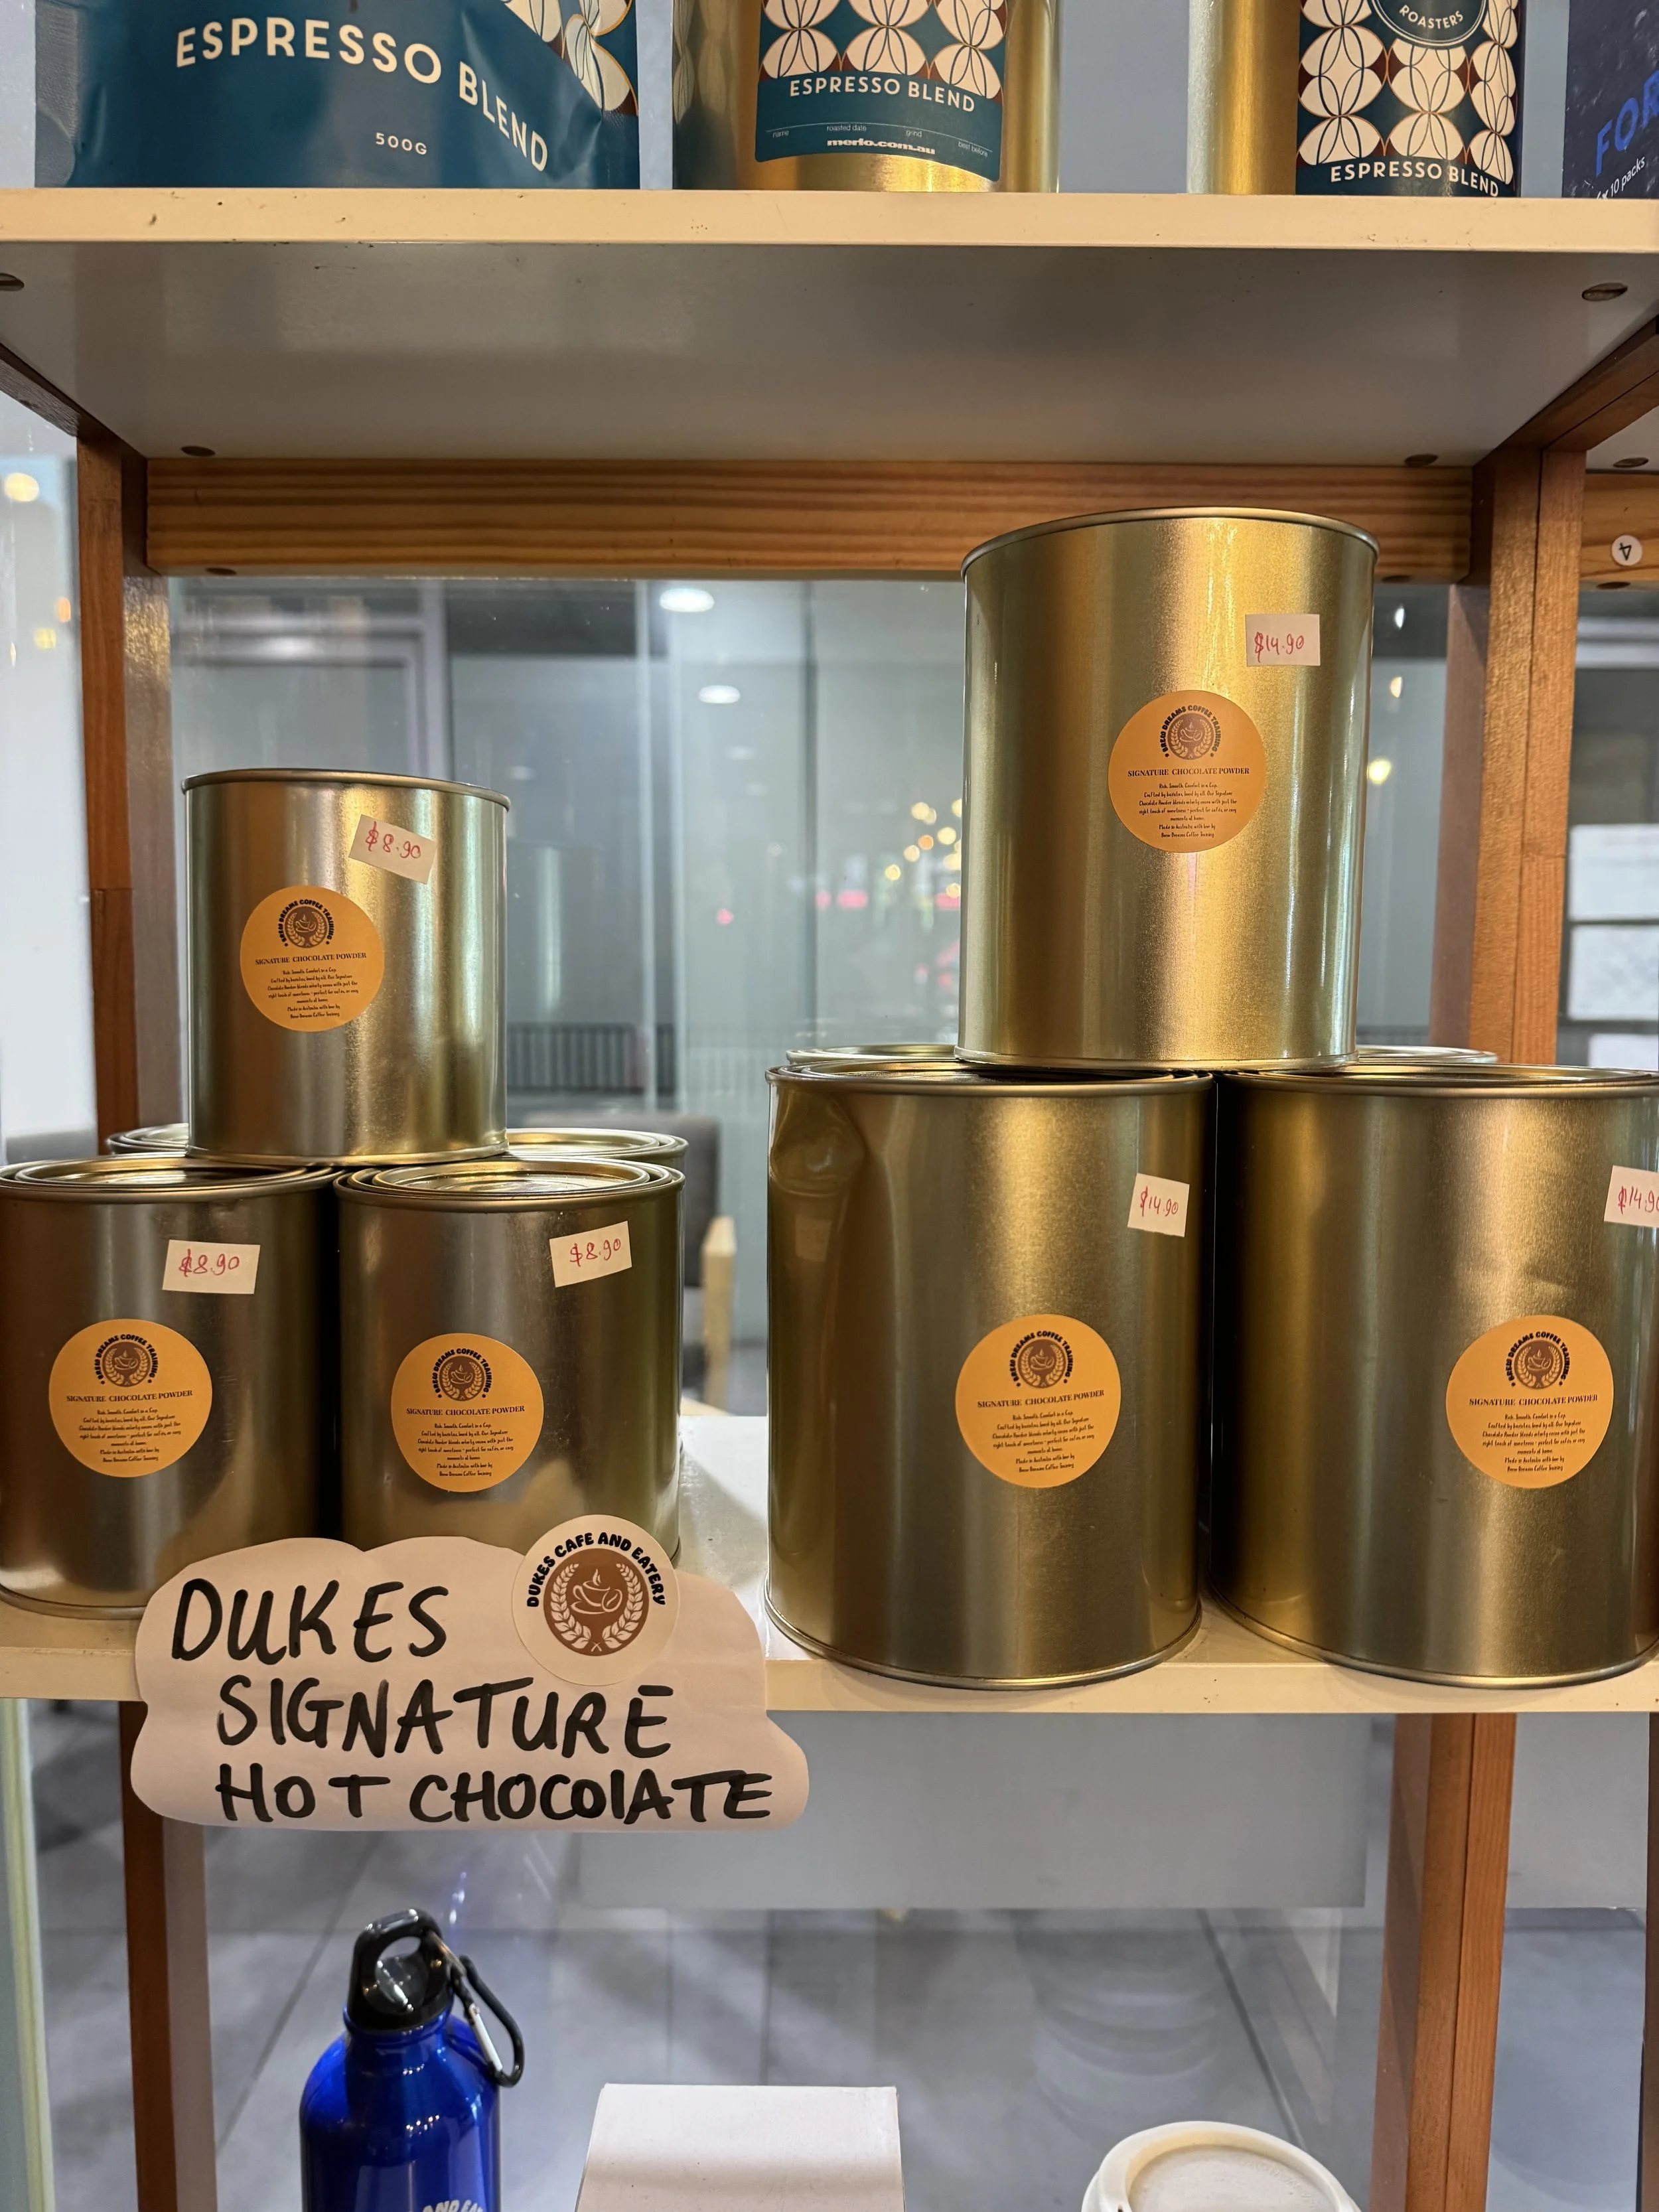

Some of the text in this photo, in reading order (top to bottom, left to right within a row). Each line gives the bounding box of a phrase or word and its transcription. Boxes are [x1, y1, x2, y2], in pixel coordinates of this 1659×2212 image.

[1399, 5, 1463, 29] ROASTERS
[176, 17, 548, 172] ESPRESSO BLEND
[790, 76, 975, 112] ESPRESSO BLEND
[375, 132, 428, 155] 500G
[772, 129, 789, 138] name
[971, 144, 988, 157] before
[828, 138, 935, 155] merlo.com.au
[1331, 161, 1499, 197] ESPRESSO BLEND
[1611, 179, 1620, 197] 10
[1621, 156, 1645, 192] packs
[1254, 631, 1304, 662] $14.90
[1163, 706, 1187, 730] DREAMS
[1187, 705, 1212, 718] COFFEE
[1211, 716, 1221, 752] TRAINING
[1127, 769, 1169, 777] SIGNATURE
[366, 821, 421, 858] $8.90
[1140, 1185, 1179, 1217] $14.90
[179, 1248, 240, 1277] $8.90
[569, 1238, 621, 1267] $8.90
[1536, 1331, 1561, 1345] COFFEE
[120, 1334, 147, 1345] COFFEE
[147, 1344, 158, 1378] TRAINING
[435, 1349, 455, 1372] DREAMS
[456, 1348, 481, 1361] COFFEE
[480, 1359, 492, 1393] TRAINING
[109, 1393, 157, 1402] CHOCOLATE
[159, 1390, 192, 1400] POWDER
[492, 1405, 525, 1414] POWDER
[977, 1389, 1104, 1408] SIGNATURE CHOCOLATE POWDER
[1469, 1394, 1598, 1406] SIGNATURE CHOCOLATE POWDER
[527, 1532, 666, 1607] DUKES CAFE AND EATERY
[171, 1578, 449, 1665] DUKES
[216, 1674, 673, 1758] SIGNATURE
[216, 1763, 391, 1824] HOT
